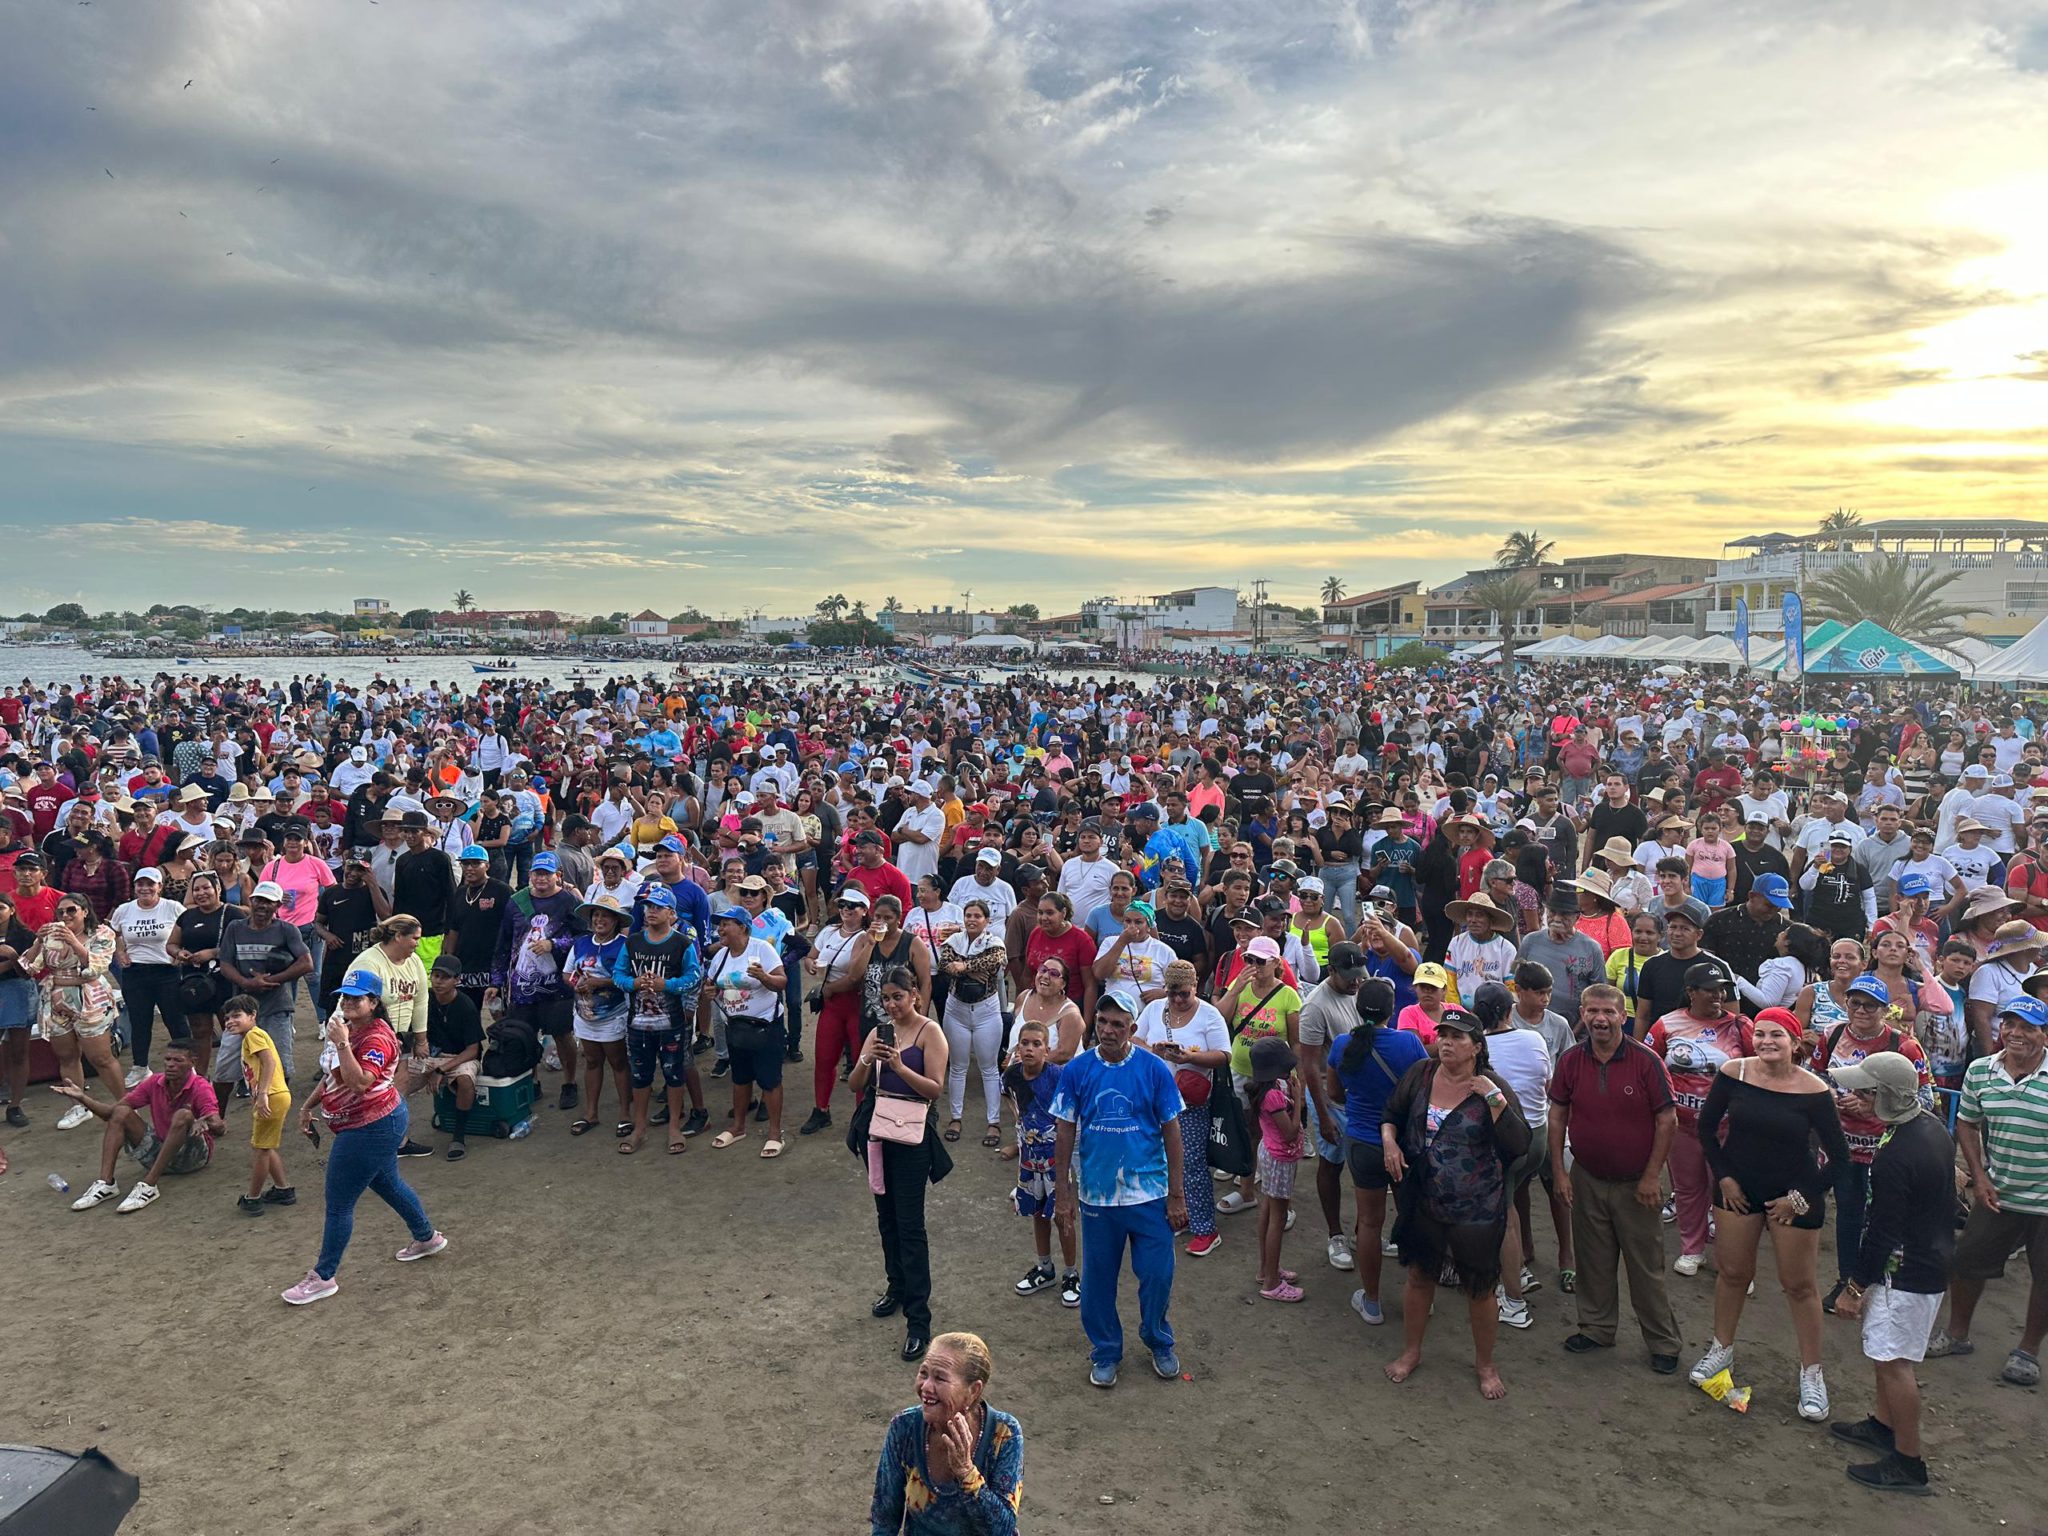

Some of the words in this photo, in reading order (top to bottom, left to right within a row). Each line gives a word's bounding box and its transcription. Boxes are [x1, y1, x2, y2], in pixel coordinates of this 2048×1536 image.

[127, 923, 166, 932] STYLING
[135, 930, 157, 938] TIPS
[1446, 1011, 1461, 1020] alo
